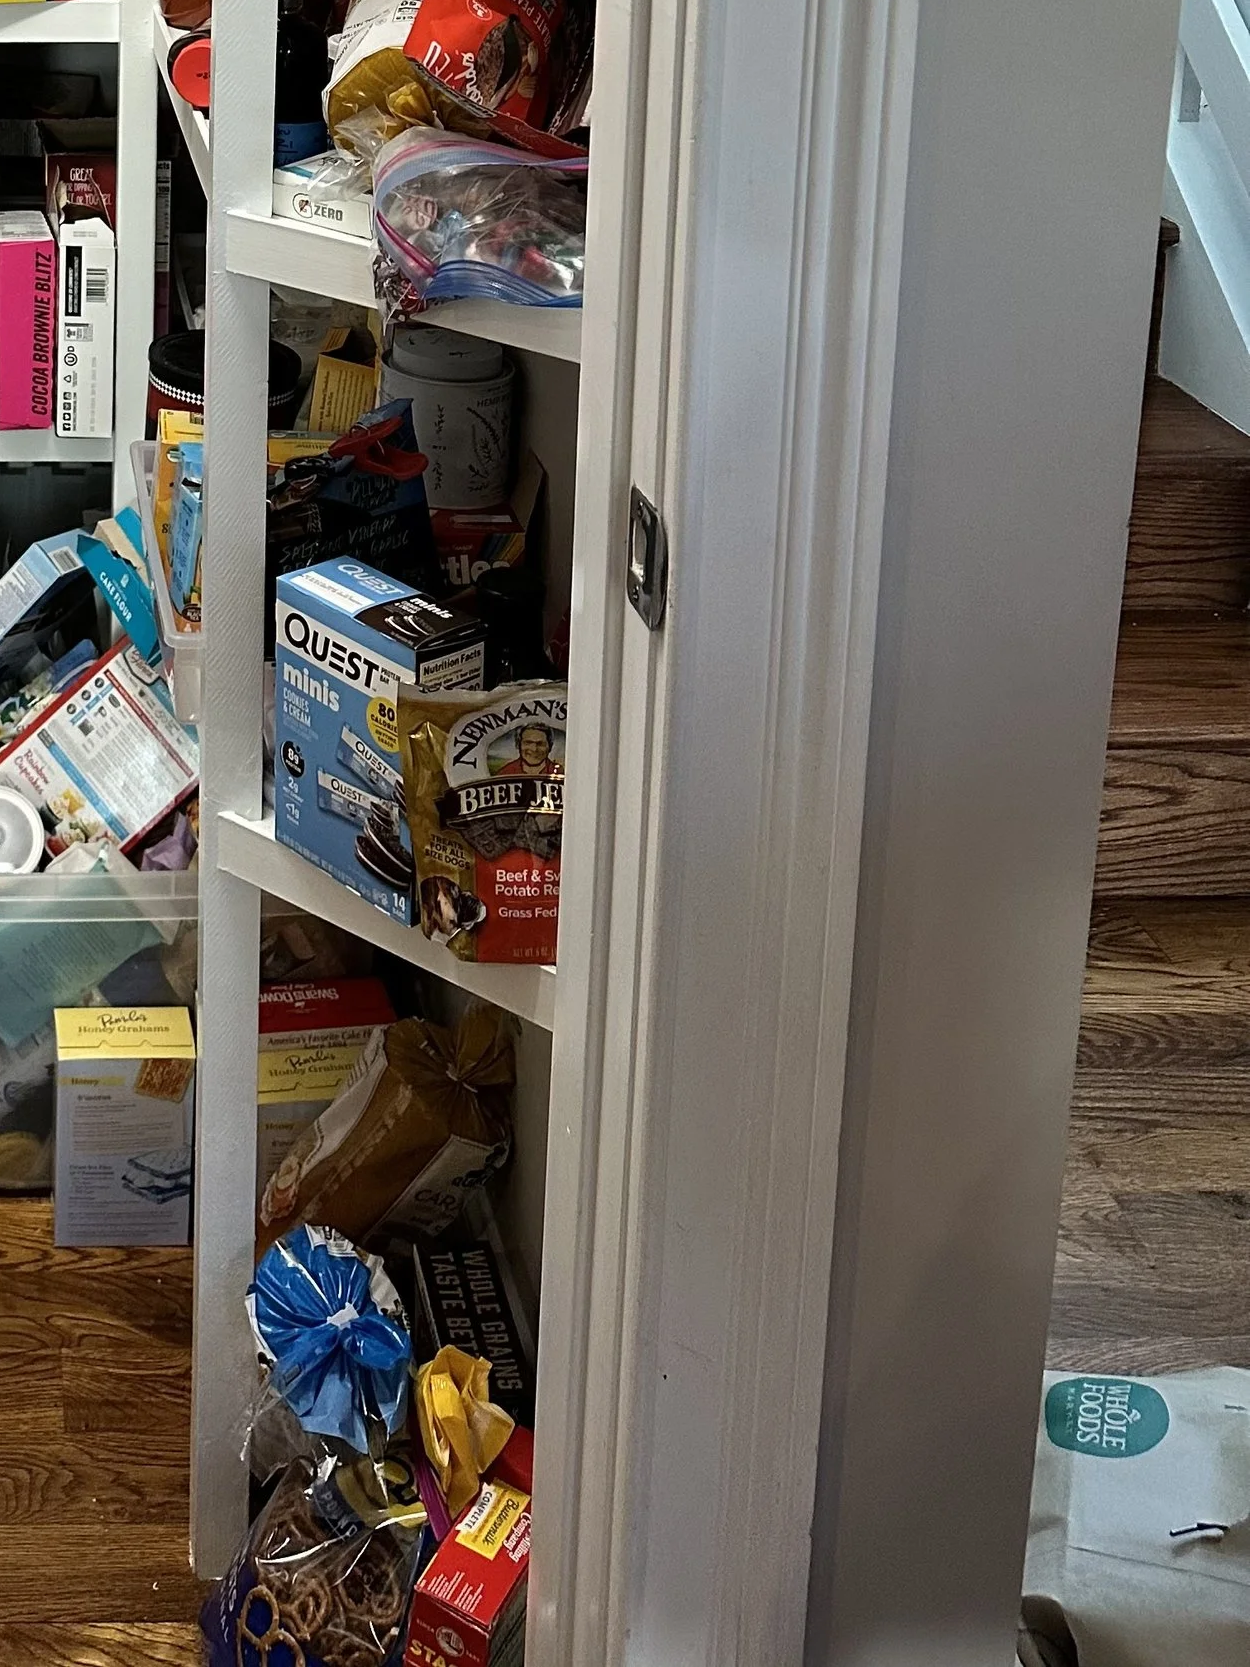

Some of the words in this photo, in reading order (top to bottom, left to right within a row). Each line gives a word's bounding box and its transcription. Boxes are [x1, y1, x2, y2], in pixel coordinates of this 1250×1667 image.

[313, 204, 344, 222] ZERO
[34, 251, 52, 290] BLITZ
[33, 294, 51, 364] BROWNIE
[31, 367, 50, 416] COCOA
[337, 563, 405, 596] QUEST
[99, 571, 117, 596] CAKE
[113, 590, 133, 623] FLOUR
[409, 597, 453, 619] minis
[284, 612, 380, 689] QUEST
[423, 657, 460, 676] Nutrition
[460, 648, 482, 665] Facts
[282, 661, 340, 712] minis
[282, 686, 310, 712] COOKIES
[288, 704, 312, 728] CREAM
[377, 702, 396, 723] 80
[354, 740, 390, 776] QUEST
[330, 777, 363, 803] QUEST
[458, 782, 524, 817] BEEF
[424, 848, 443, 862] SIZE
[443, 854, 471, 871] DOGS
[430, 841, 449, 854] FOR
[449, 848, 466, 860] ALL
[495, 869, 529, 883] Beef
[531, 869, 542, 883] &
[495, 884, 540, 897] Potato
[392, 891, 407, 913] 14
[498, 906, 533, 919] Grass
[535, 906, 558, 918] Fed
[77, 1025, 116, 1035] Honey
[117, 1024, 171, 1034] Grahams
[429, 1251, 467, 1310] TASTE
[461, 1248, 501, 1315] WHOLE
[481, 1320, 523, 1390] GRAINS
[1075, 1382, 1105, 1445] FOODS
[1100, 1383, 1132, 1452] WHOLE
[463, 1491, 493, 1530] COMPLETE
